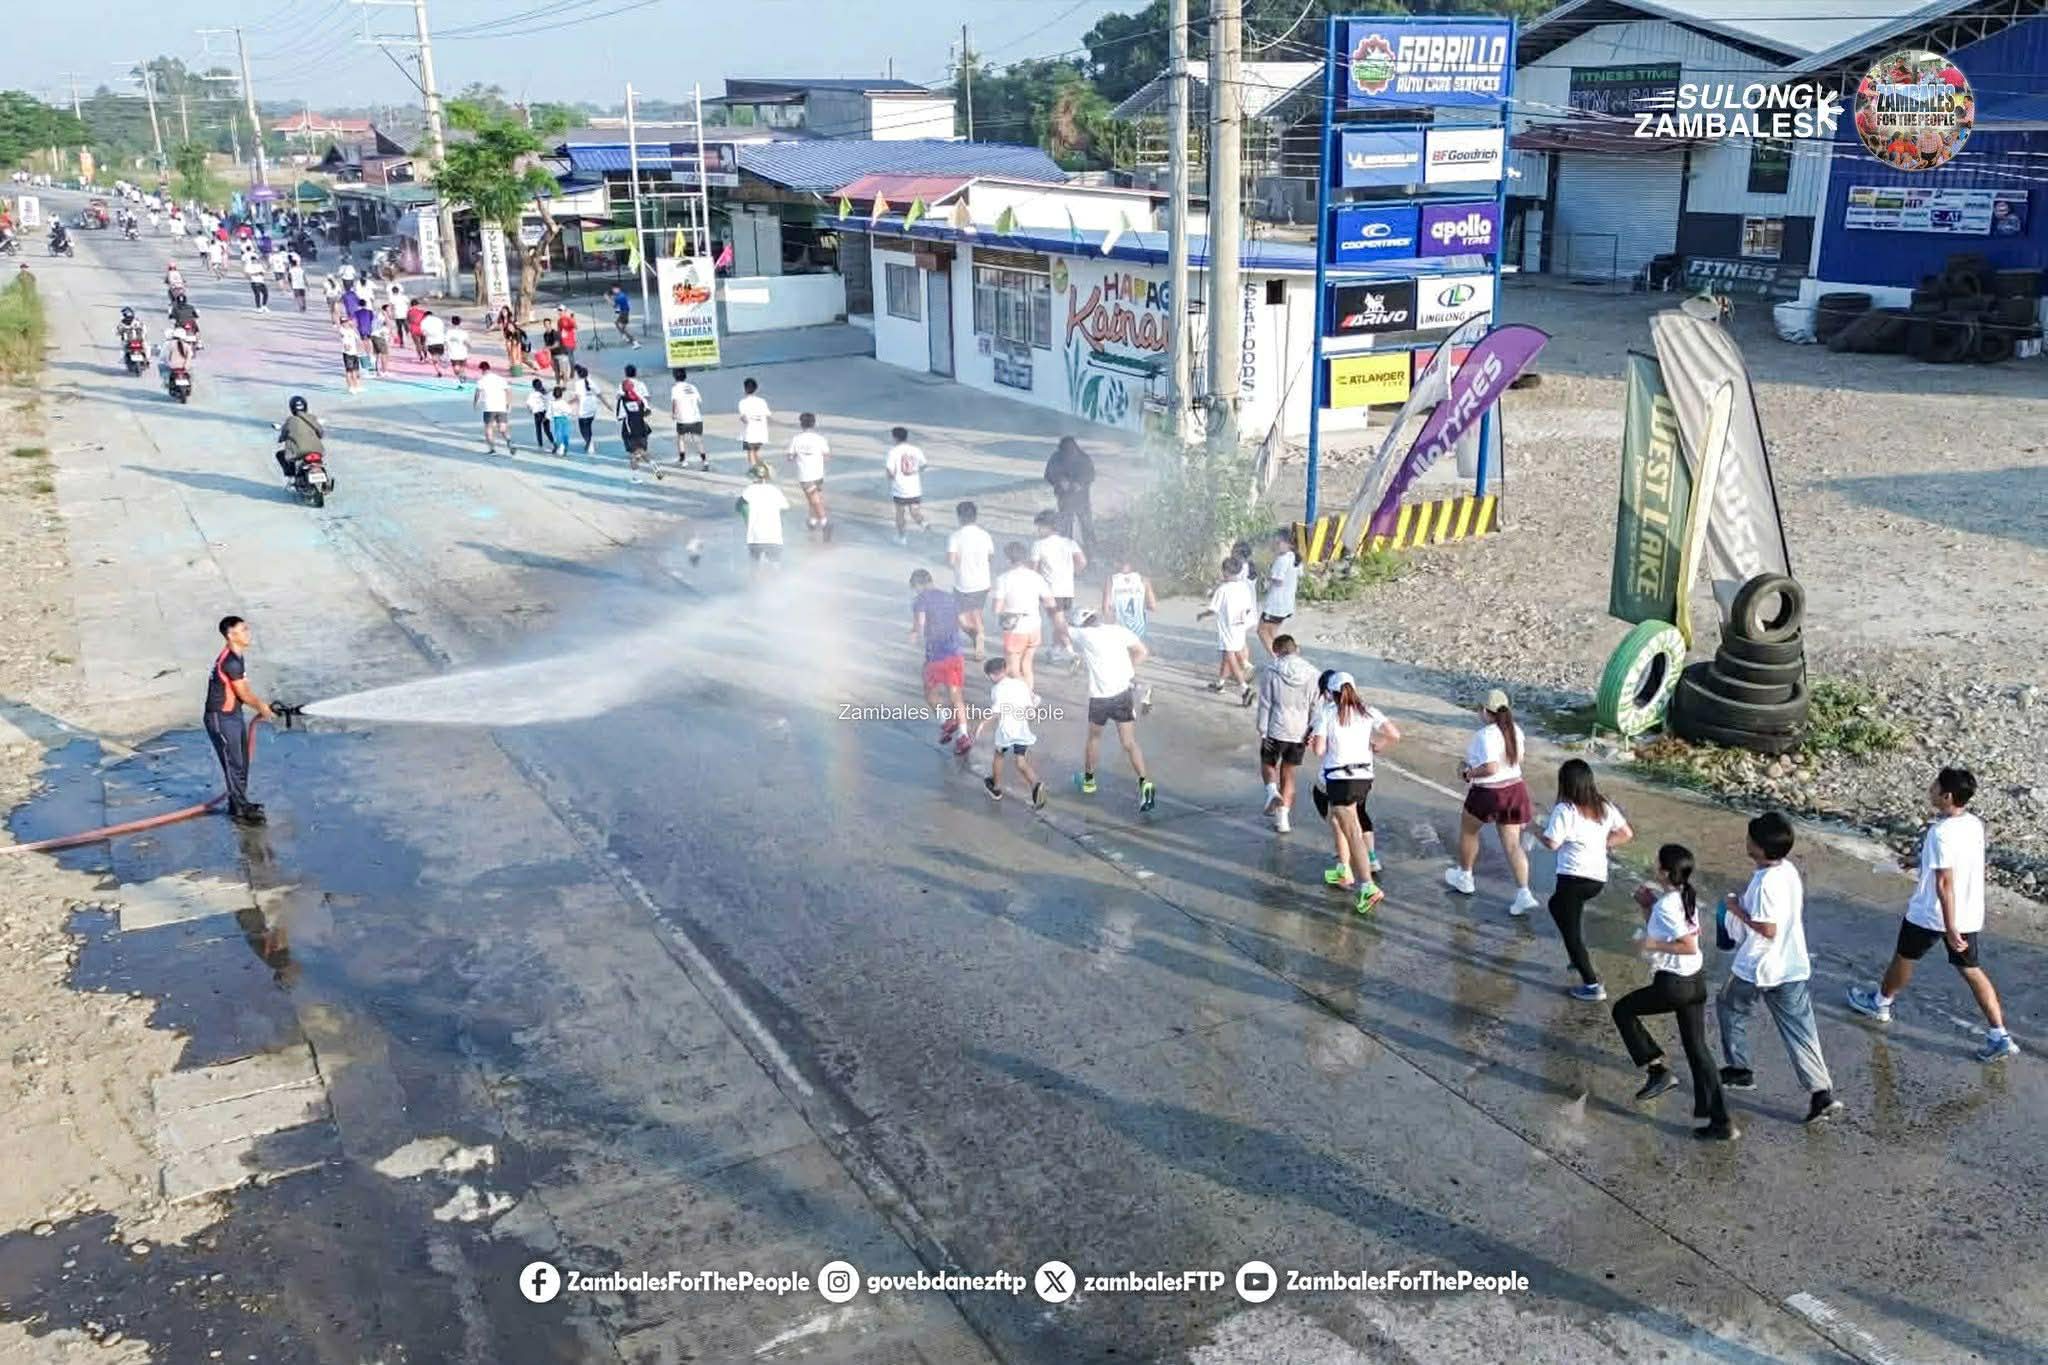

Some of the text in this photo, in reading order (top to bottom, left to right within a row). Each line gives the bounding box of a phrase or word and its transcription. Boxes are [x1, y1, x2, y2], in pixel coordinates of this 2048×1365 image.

[1396, 35, 1507, 73] GABRILLO
[1396, 76, 1424, 92] AUTO
[1637, 69, 1679, 80] TIME
[1431, 148, 1498, 162] BFGoodrich
[1931, 211, 1960, 221] CAT
[1430, 213, 1493, 246] apollo
[1688, 260, 1778, 281] FITNESS
[1349, 310, 1408, 328] ARIVO
[1420, 310, 1465, 325] LINGLONG
[1242, 282, 1257, 392] SEAFOODS
[1349, 371, 1406, 386] ATLANDER
[1437, 351, 1502, 450] TYRES
[1636, 394, 1678, 601] WEST LAKE
[1125, 597, 1136, 617] 4
